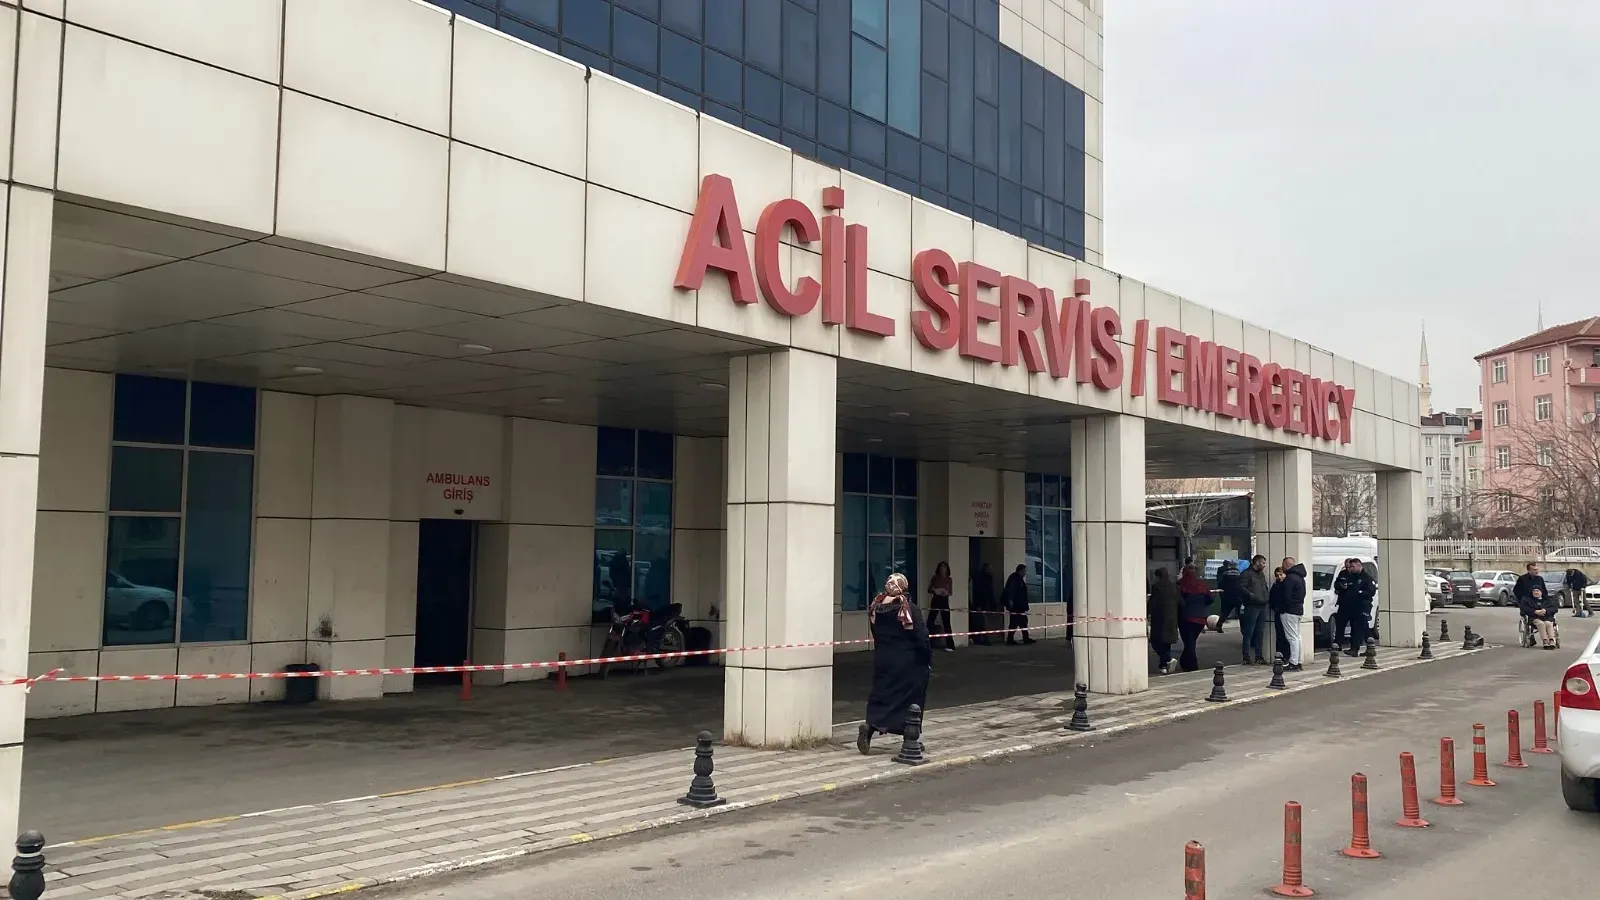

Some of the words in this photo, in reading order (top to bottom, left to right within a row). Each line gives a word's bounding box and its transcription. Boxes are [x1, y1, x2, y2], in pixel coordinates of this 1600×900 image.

[674, 173, 896, 338] ACİL
[910, 248, 1124, 391] SERVİS
[1156, 326, 1356, 444] EMERGENCY
[426, 472, 491, 487] AMBULANS
[443, 487, 474, 504] GİRİŞ
